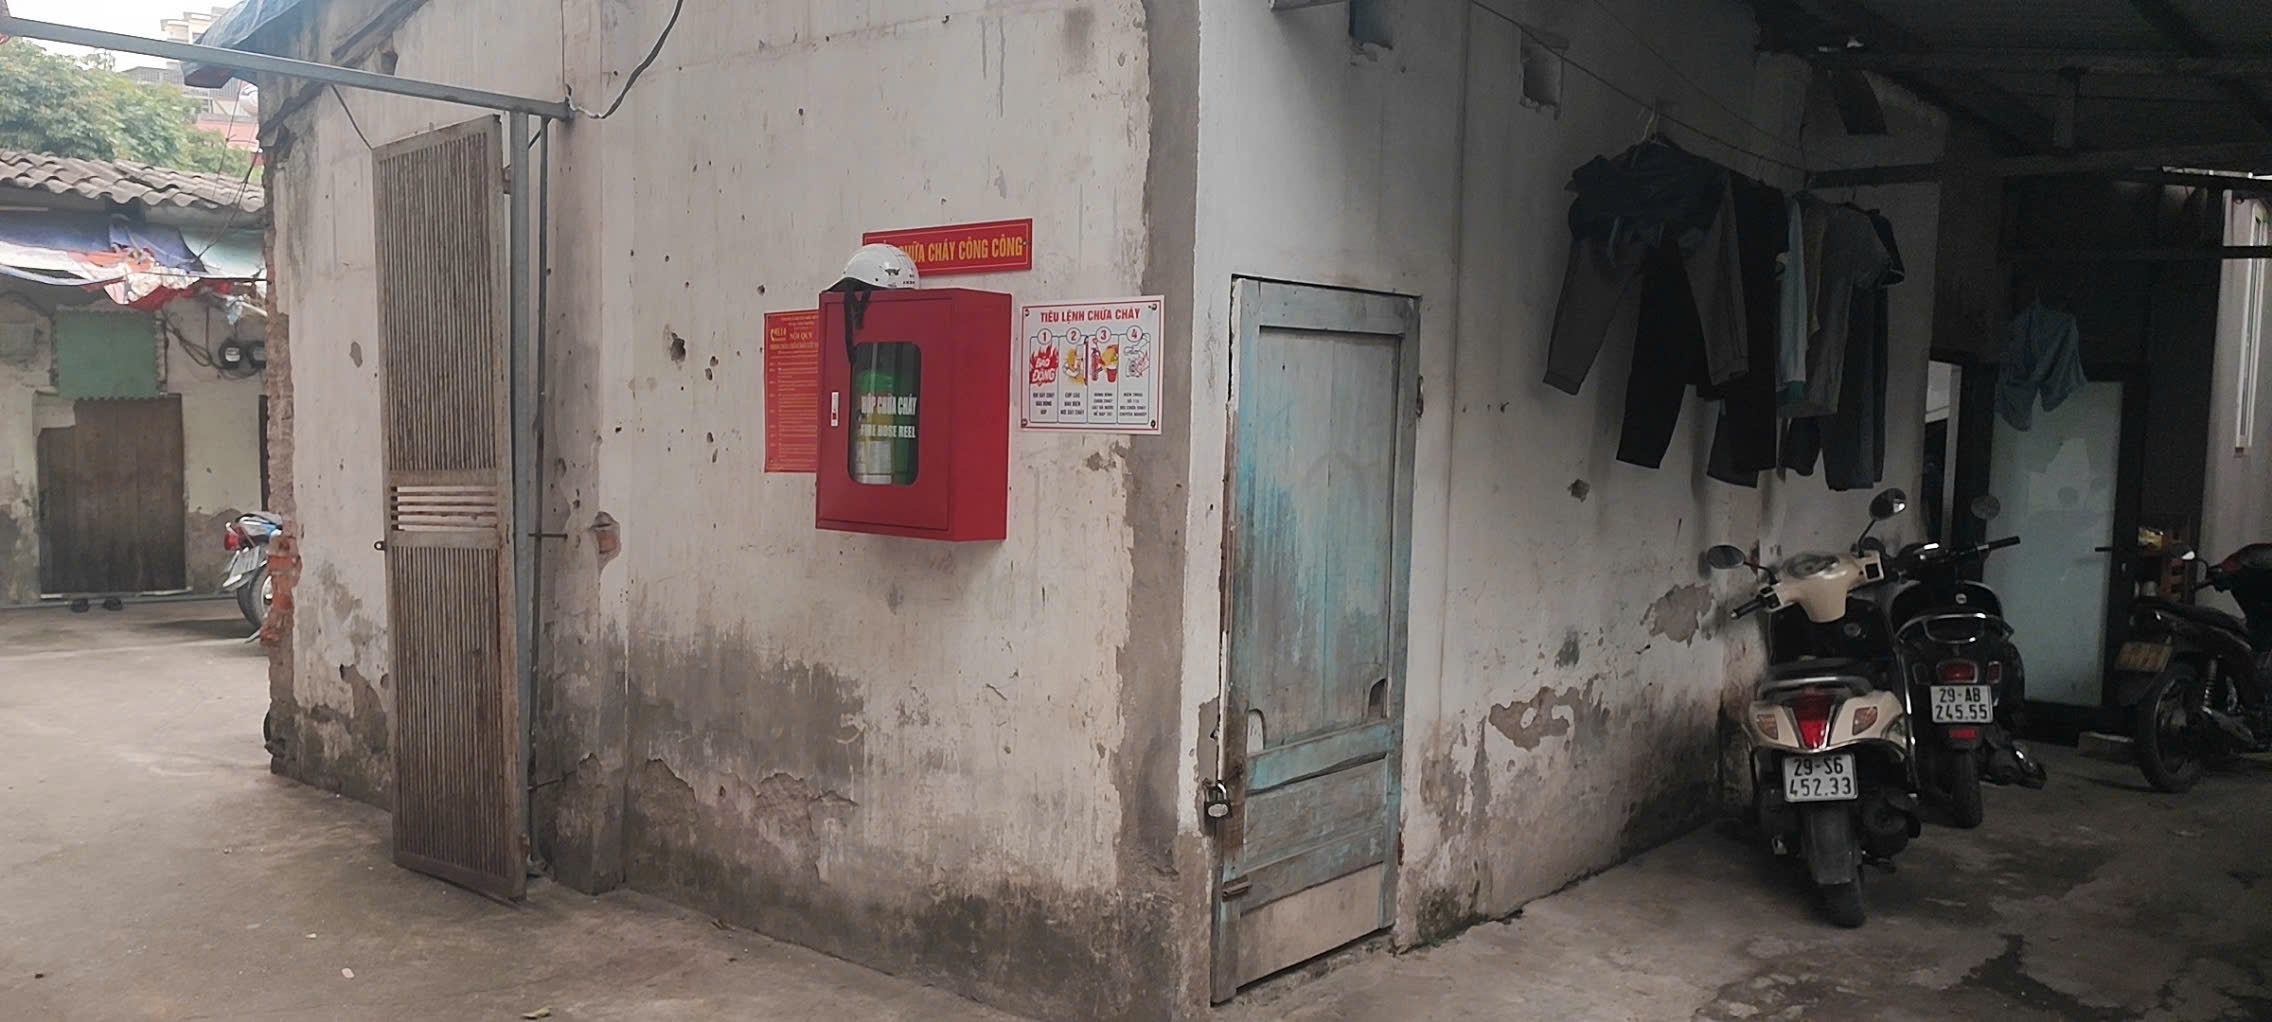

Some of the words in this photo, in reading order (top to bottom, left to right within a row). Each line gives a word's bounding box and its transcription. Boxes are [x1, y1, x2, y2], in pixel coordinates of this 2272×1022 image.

[928, 238, 956, 262] CHÁY
[958, 235, 989, 260] CÔNG
[1040, 309, 1059, 323] TIÊU
[1062, 309, 1085, 325] LỆNH
[1115, 306, 1140, 320] CHÁY
[1042, 331, 1047, 342] 1
[1070, 330, 1077, 341] 2
[1100, 329, 1107, 341] 3
[1131, 328, 1138, 339] 4
[877, 424, 897, 438] HOSE
[898, 425, 917, 439] REEL
[1938, 687, 1981, 703] 29-AB
[1935, 704, 1988, 720] 245.55
[1793, 757, 1844, 776] 29-S6
[1789, 778, 1853, 798] 452.33
